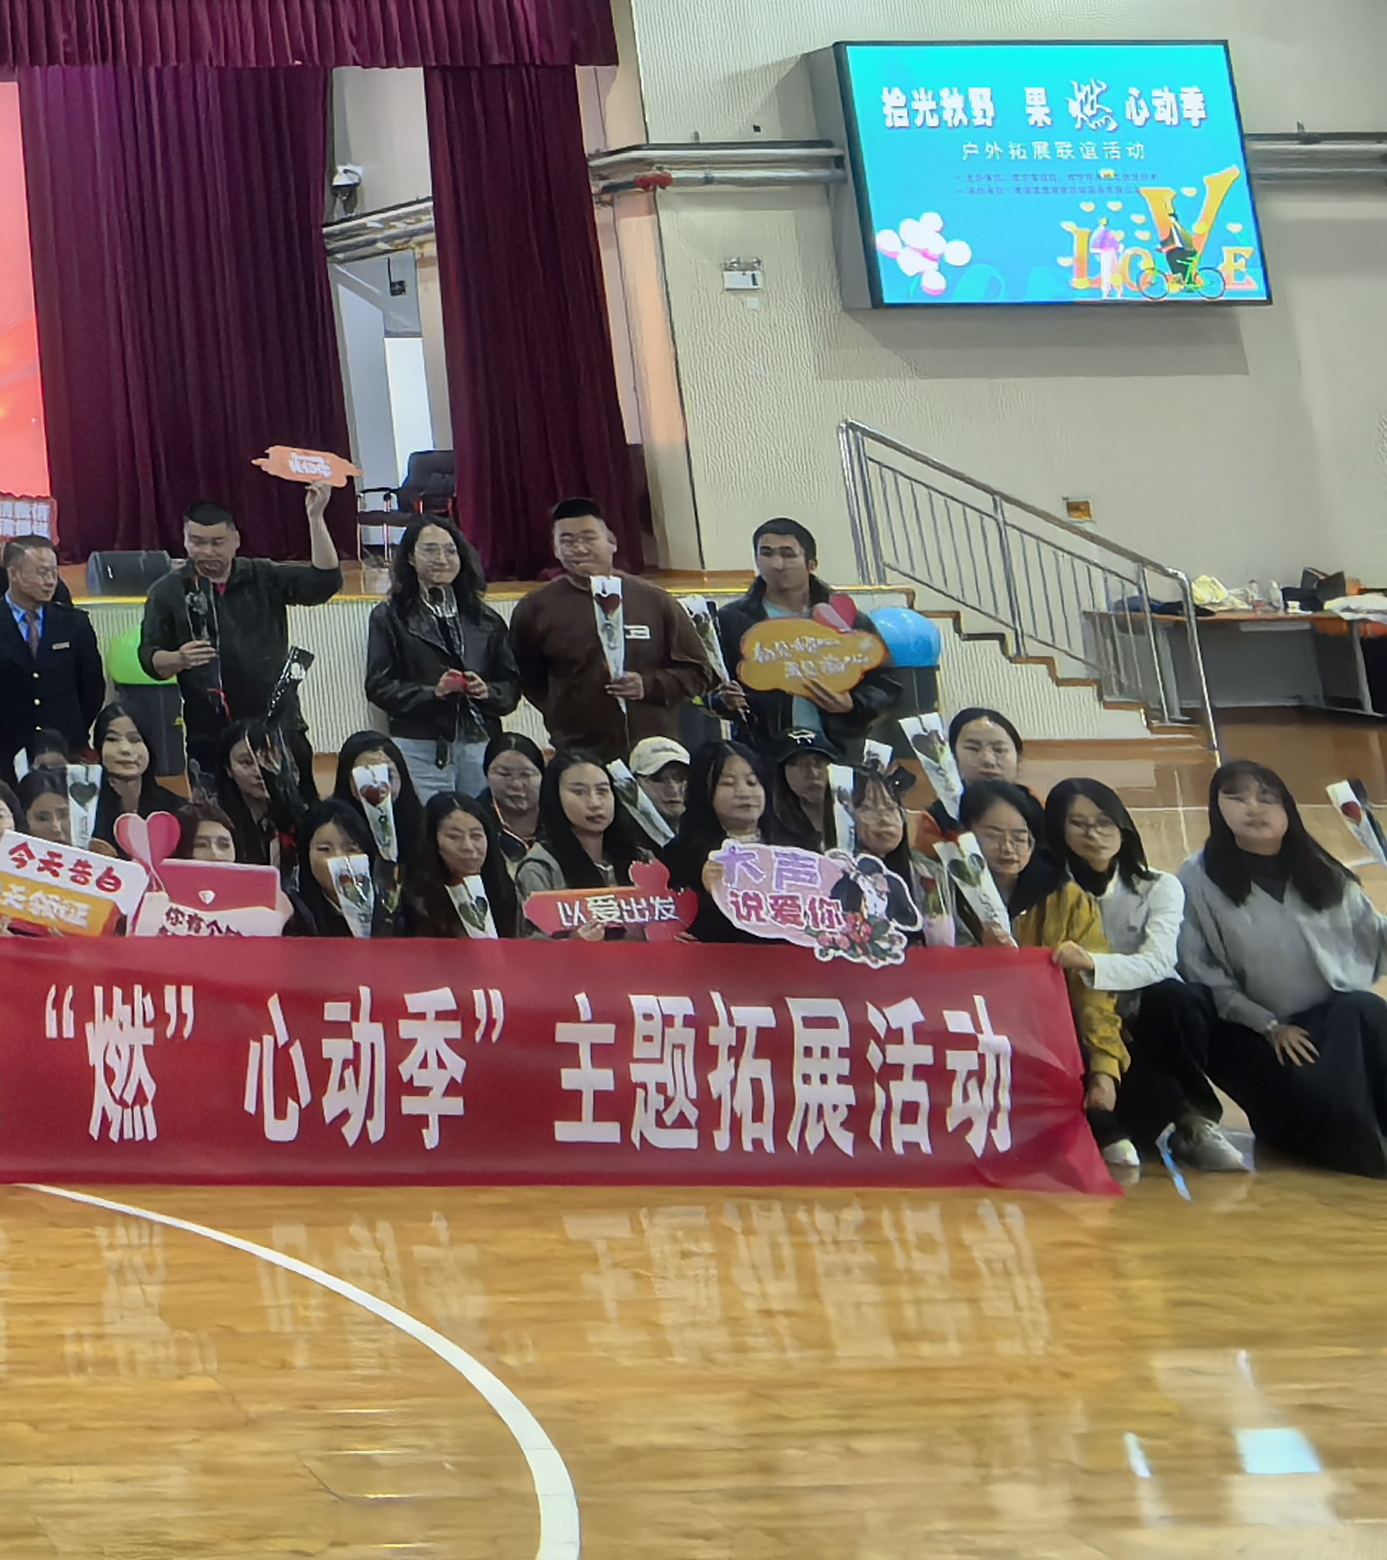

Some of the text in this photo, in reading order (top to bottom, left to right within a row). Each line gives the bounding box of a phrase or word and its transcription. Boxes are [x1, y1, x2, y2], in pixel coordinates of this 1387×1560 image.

[881, 85, 996, 130] 拾光秋野
[961, 141, 1147, 162] 户外拓展联谊活动
[8, 840, 123, 893] 今天告白
[712, 847, 822, 889] 大声
[556, 894, 680, 928] 以爱出发
[729, 891, 848, 931] 说爱你
